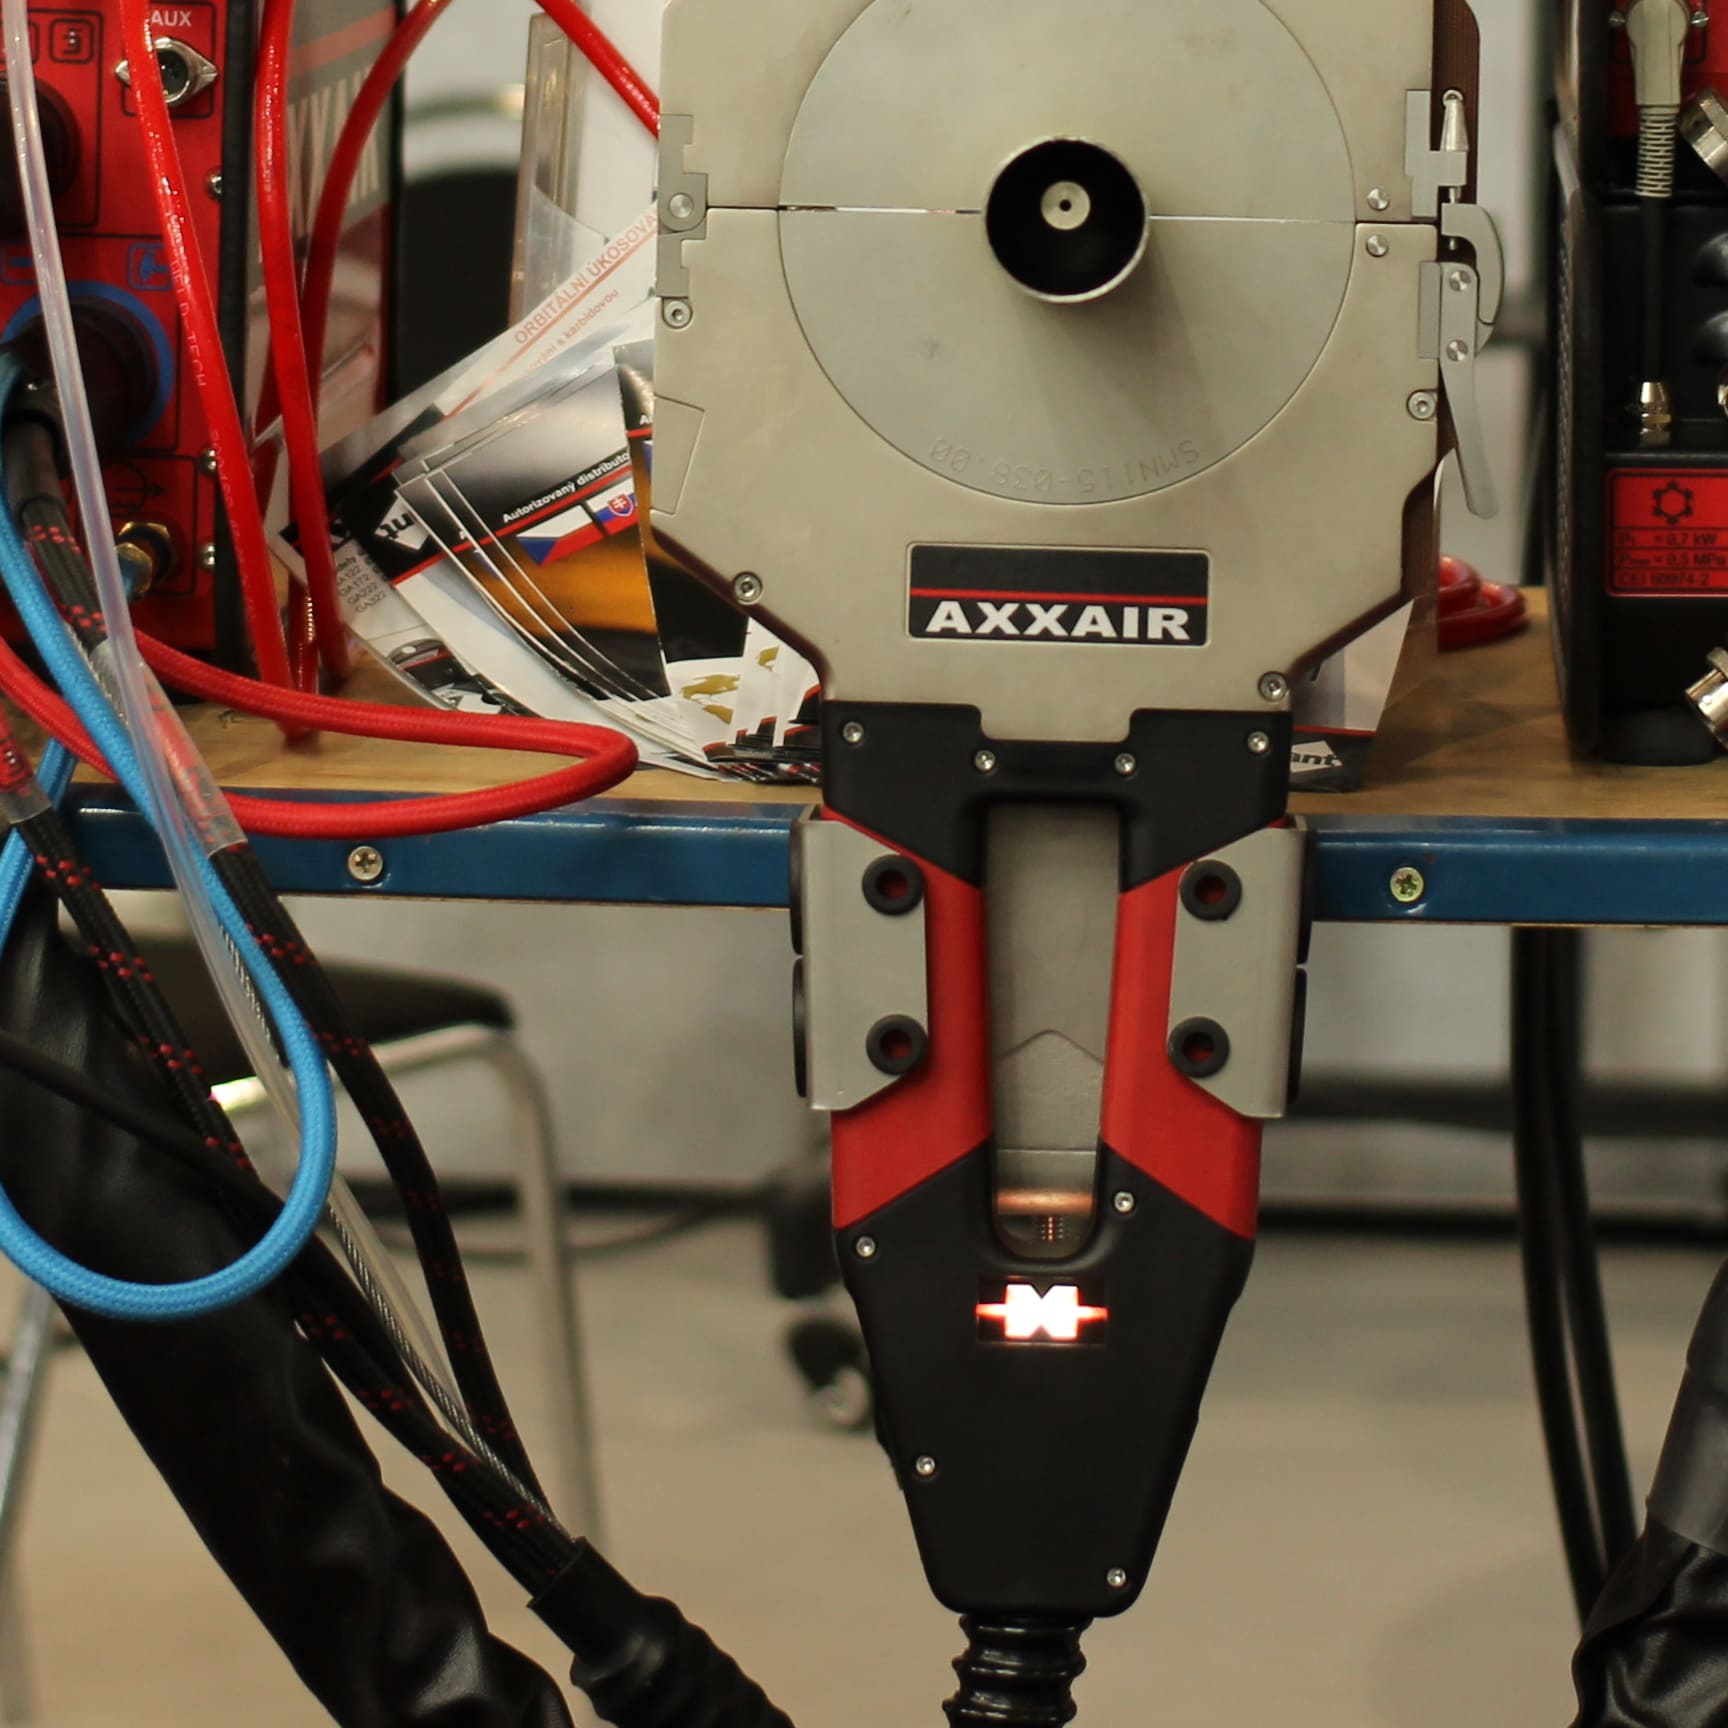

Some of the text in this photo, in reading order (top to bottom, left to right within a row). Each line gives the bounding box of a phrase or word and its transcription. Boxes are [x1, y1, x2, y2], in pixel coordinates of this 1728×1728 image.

[150, 9, 192, 28] AUX
[501, 452, 631, 524] Autorizovaný distributo
[924, 600, 1191, 641] AXXAIR
